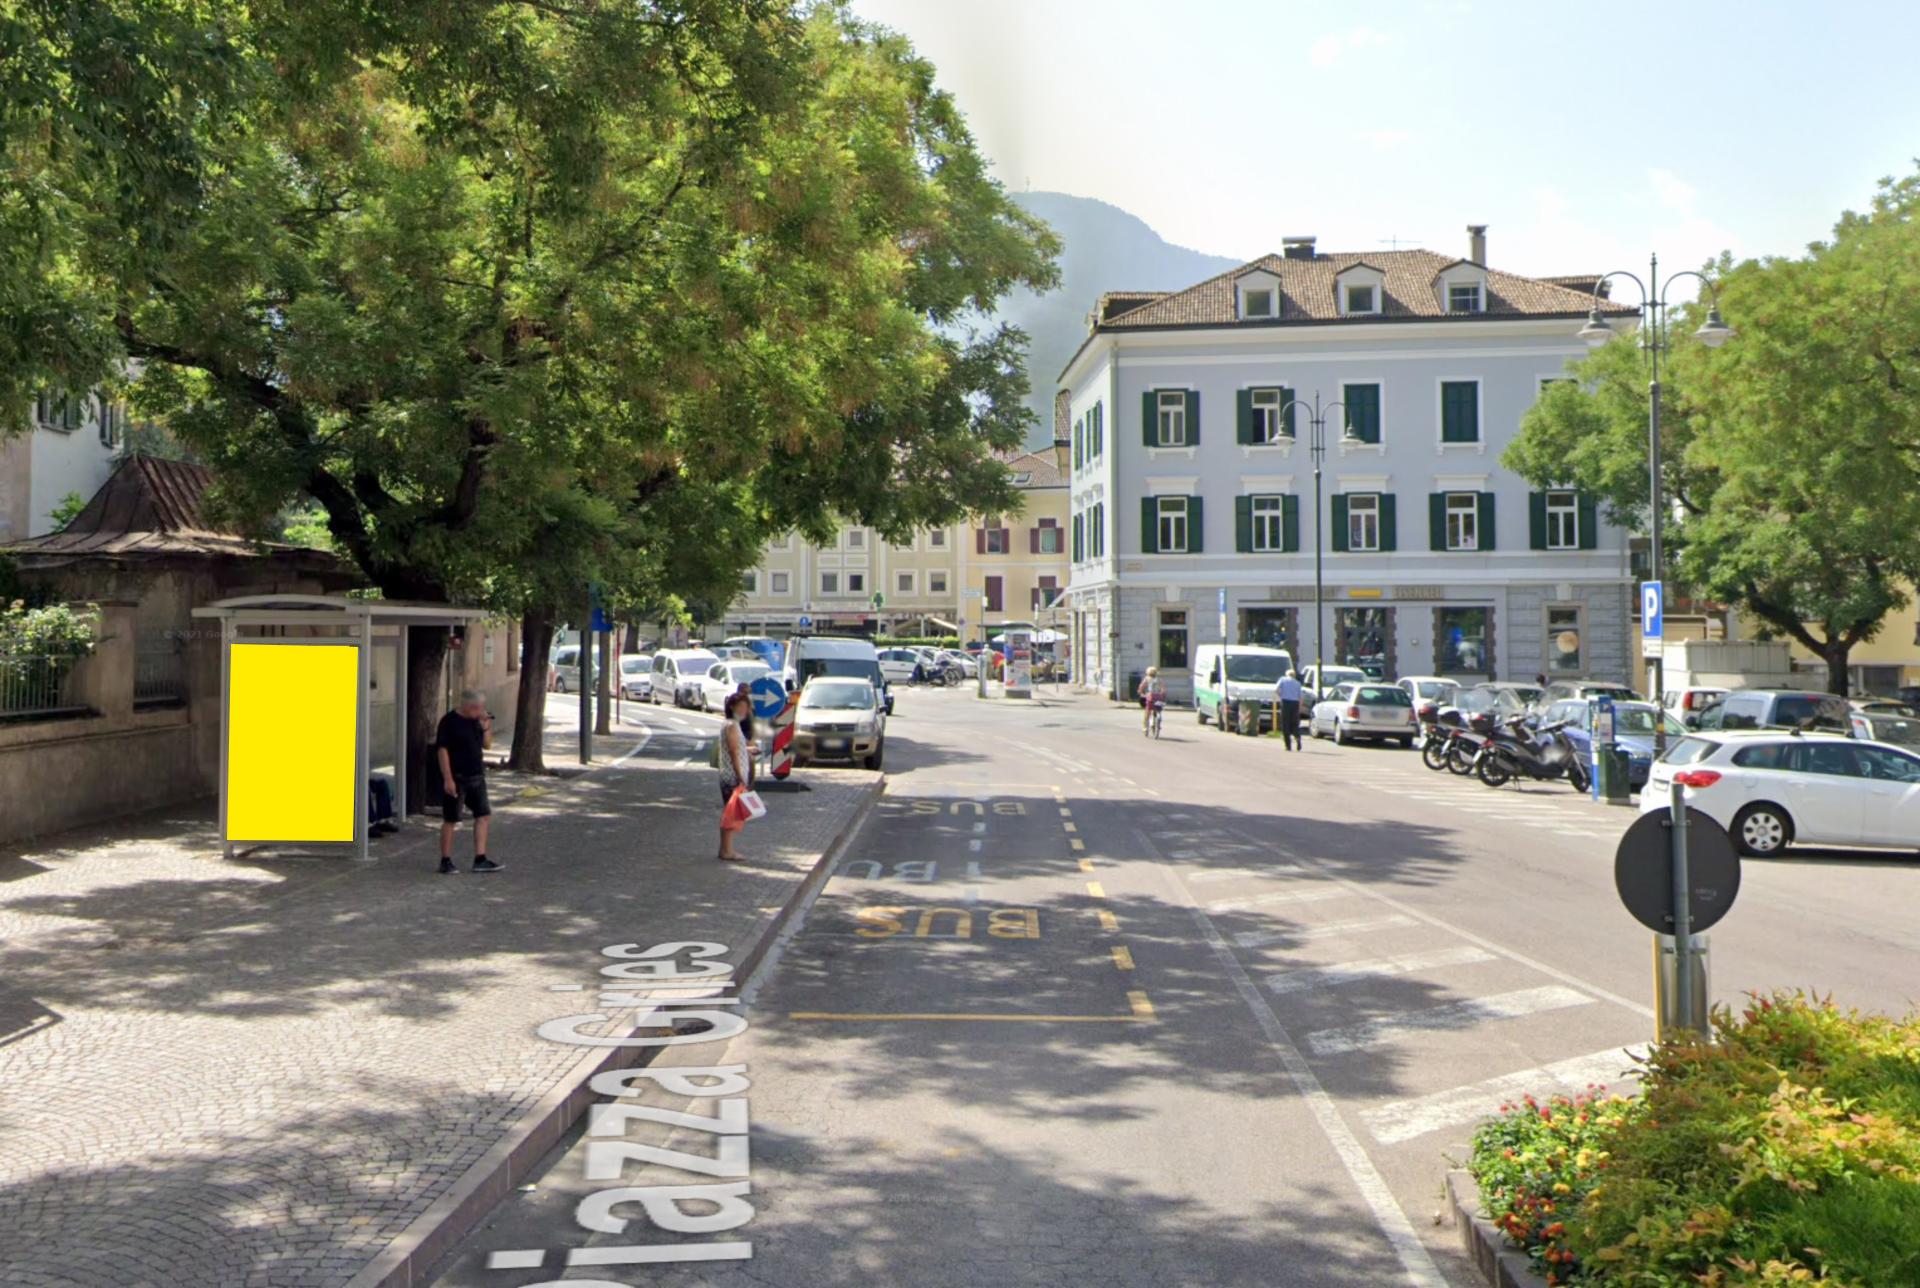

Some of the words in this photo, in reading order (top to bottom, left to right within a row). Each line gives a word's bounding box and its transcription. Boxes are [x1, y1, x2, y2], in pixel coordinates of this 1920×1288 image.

[1644, 587, 1658, 632] P
[913, 801, 1027, 816] BUS
[855, 907, 1041, 939] BUS
